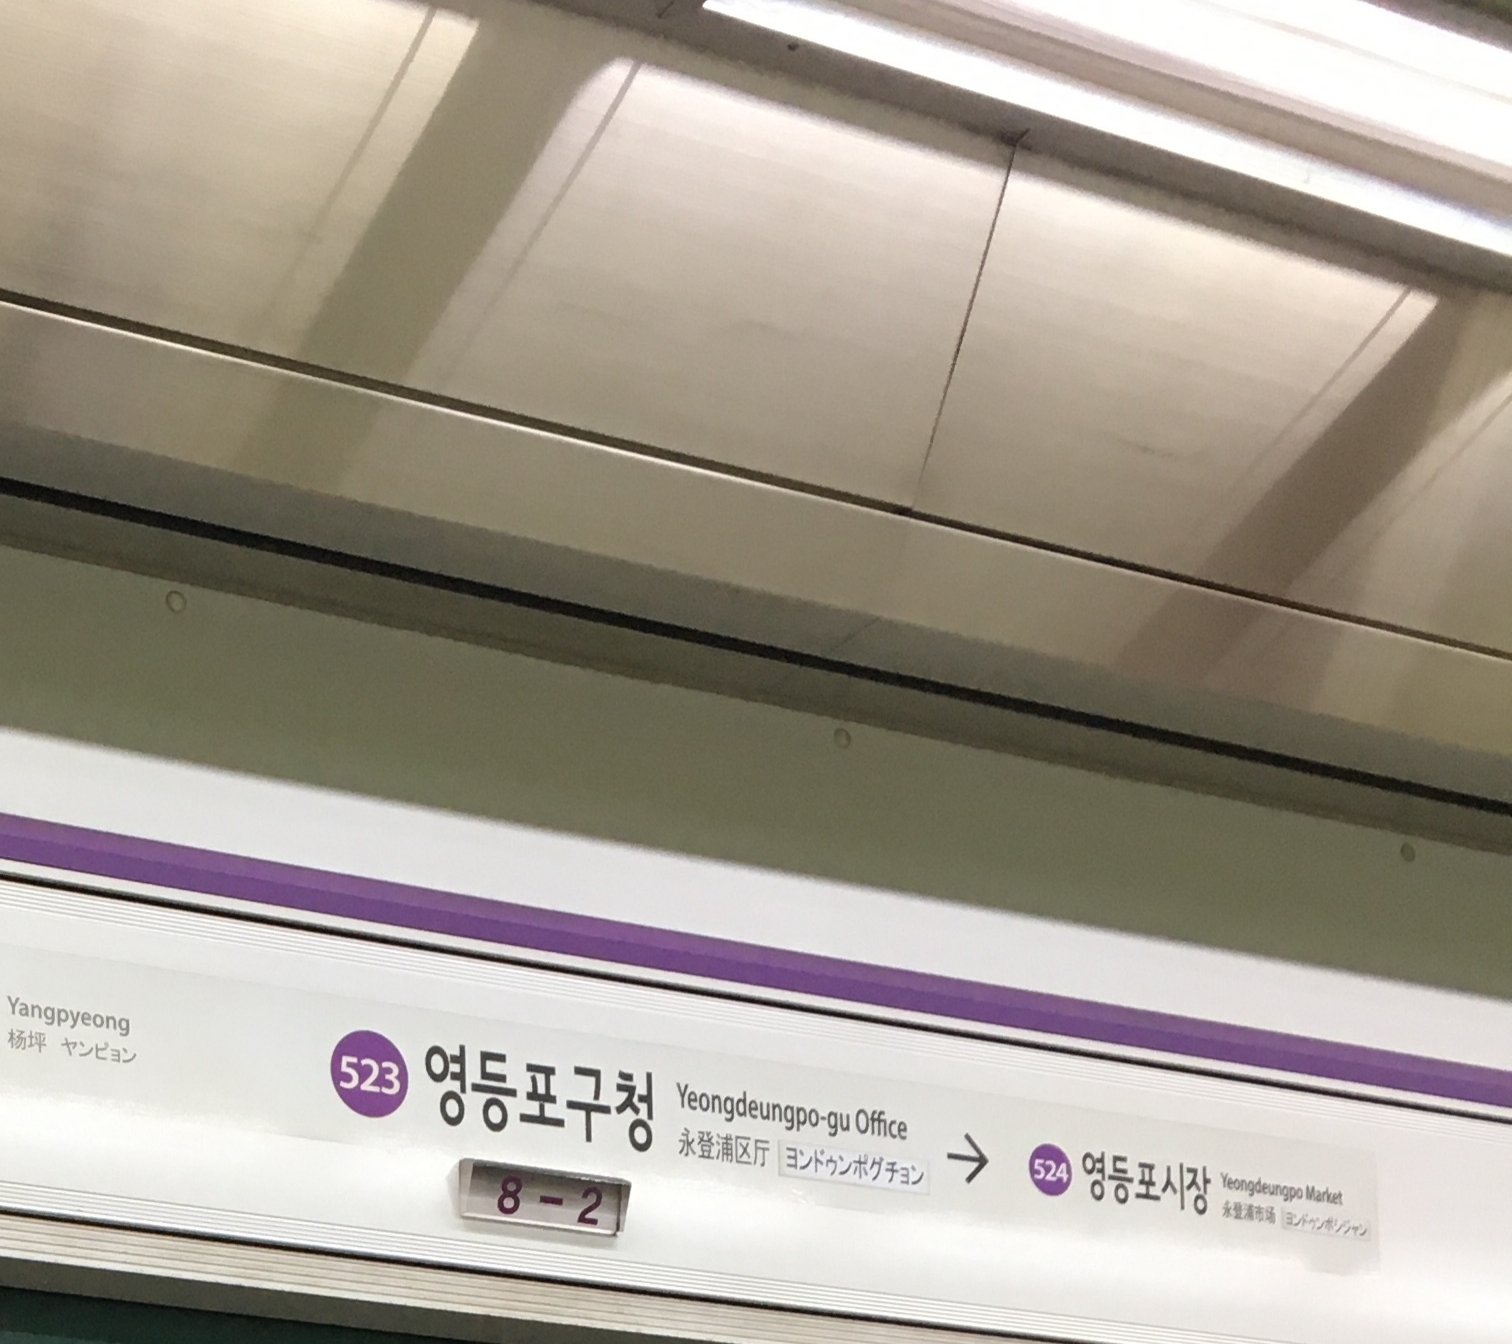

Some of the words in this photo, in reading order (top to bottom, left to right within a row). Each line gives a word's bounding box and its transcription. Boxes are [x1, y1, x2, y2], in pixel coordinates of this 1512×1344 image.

[7, 995, 130, 1037] Yangpyeong
[61, 1037, 137, 1064] ヤンピョン
[338, 1056, 402, 1096] 523
[425, 1044, 654, 1152] 영등포구청
[676, 1082, 850, 1137] Yeongdeungpo-gu
[855, 1108, 908, 1140] Office
[678, 1127, 770, 1167] 永登浦区厅
[1033, 1158, 1069, 1184] 524
[1082, 1150, 1211, 1216] 영등포시장
[1220, 1172, 1303, 1202] Yeongdeungpo
[1306, 1184, 1343, 1206] Market
